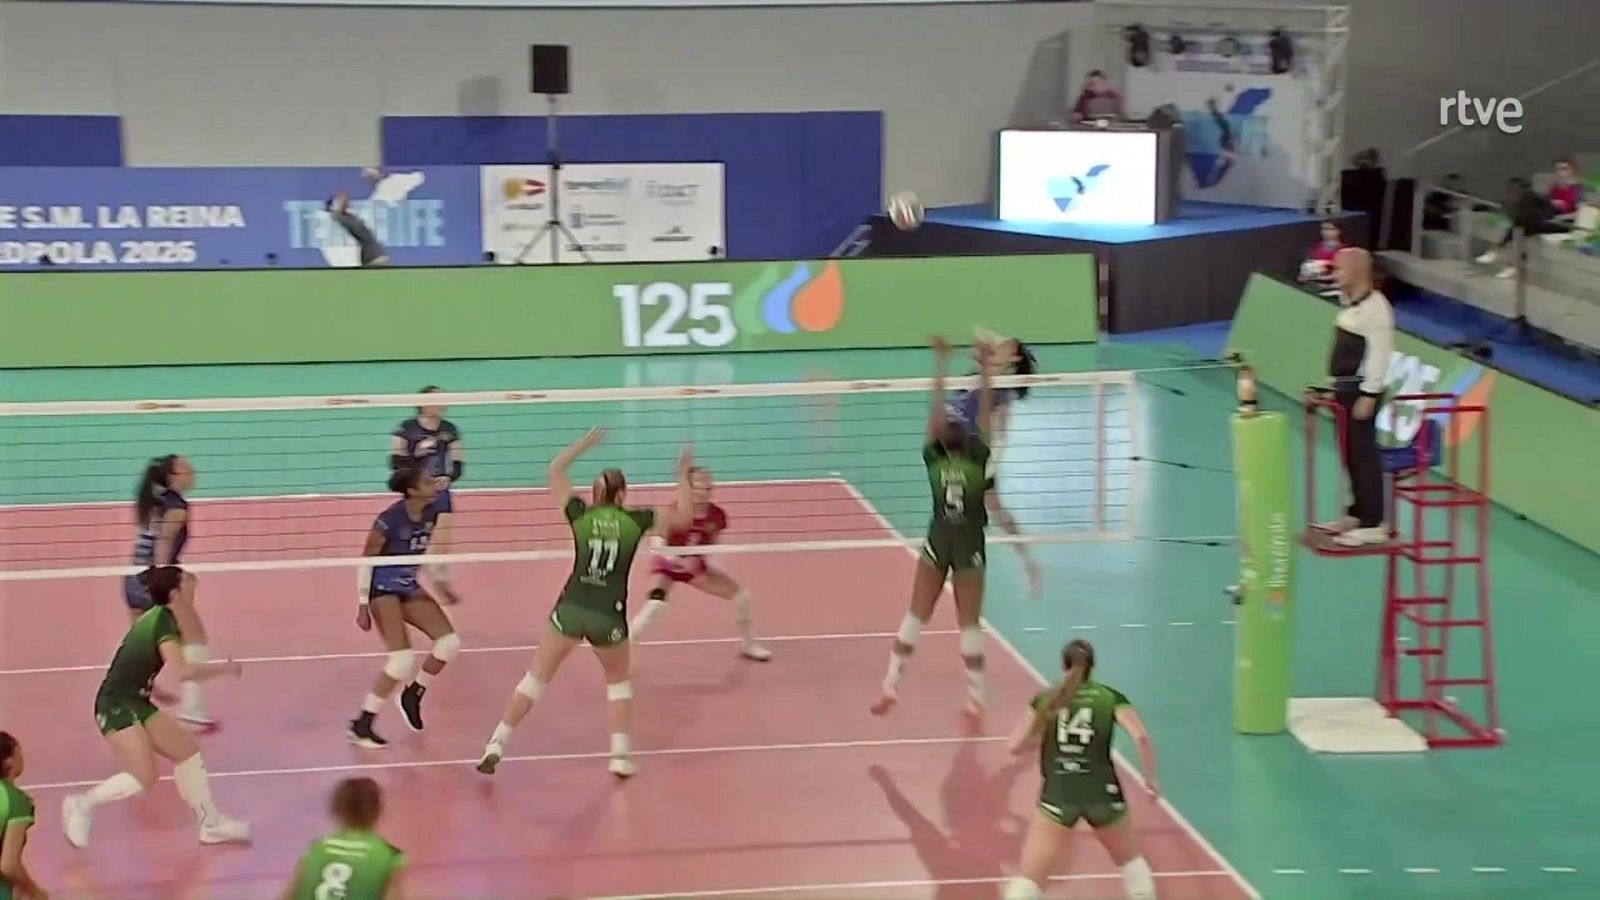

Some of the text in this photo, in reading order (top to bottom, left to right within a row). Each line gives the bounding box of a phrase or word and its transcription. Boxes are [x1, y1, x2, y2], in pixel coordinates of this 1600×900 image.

[20, 206, 94, 229] S.M.
[97, 206, 142, 228] LA
[146, 205, 246, 228] REINA
[283, 200, 447, 249] TERIFE
[121, 240, 197, 264] 2026
[613, 282, 737, 347] 125
[1056, 706, 1095, 744] 14
[314, 861, 353, 900] 8
